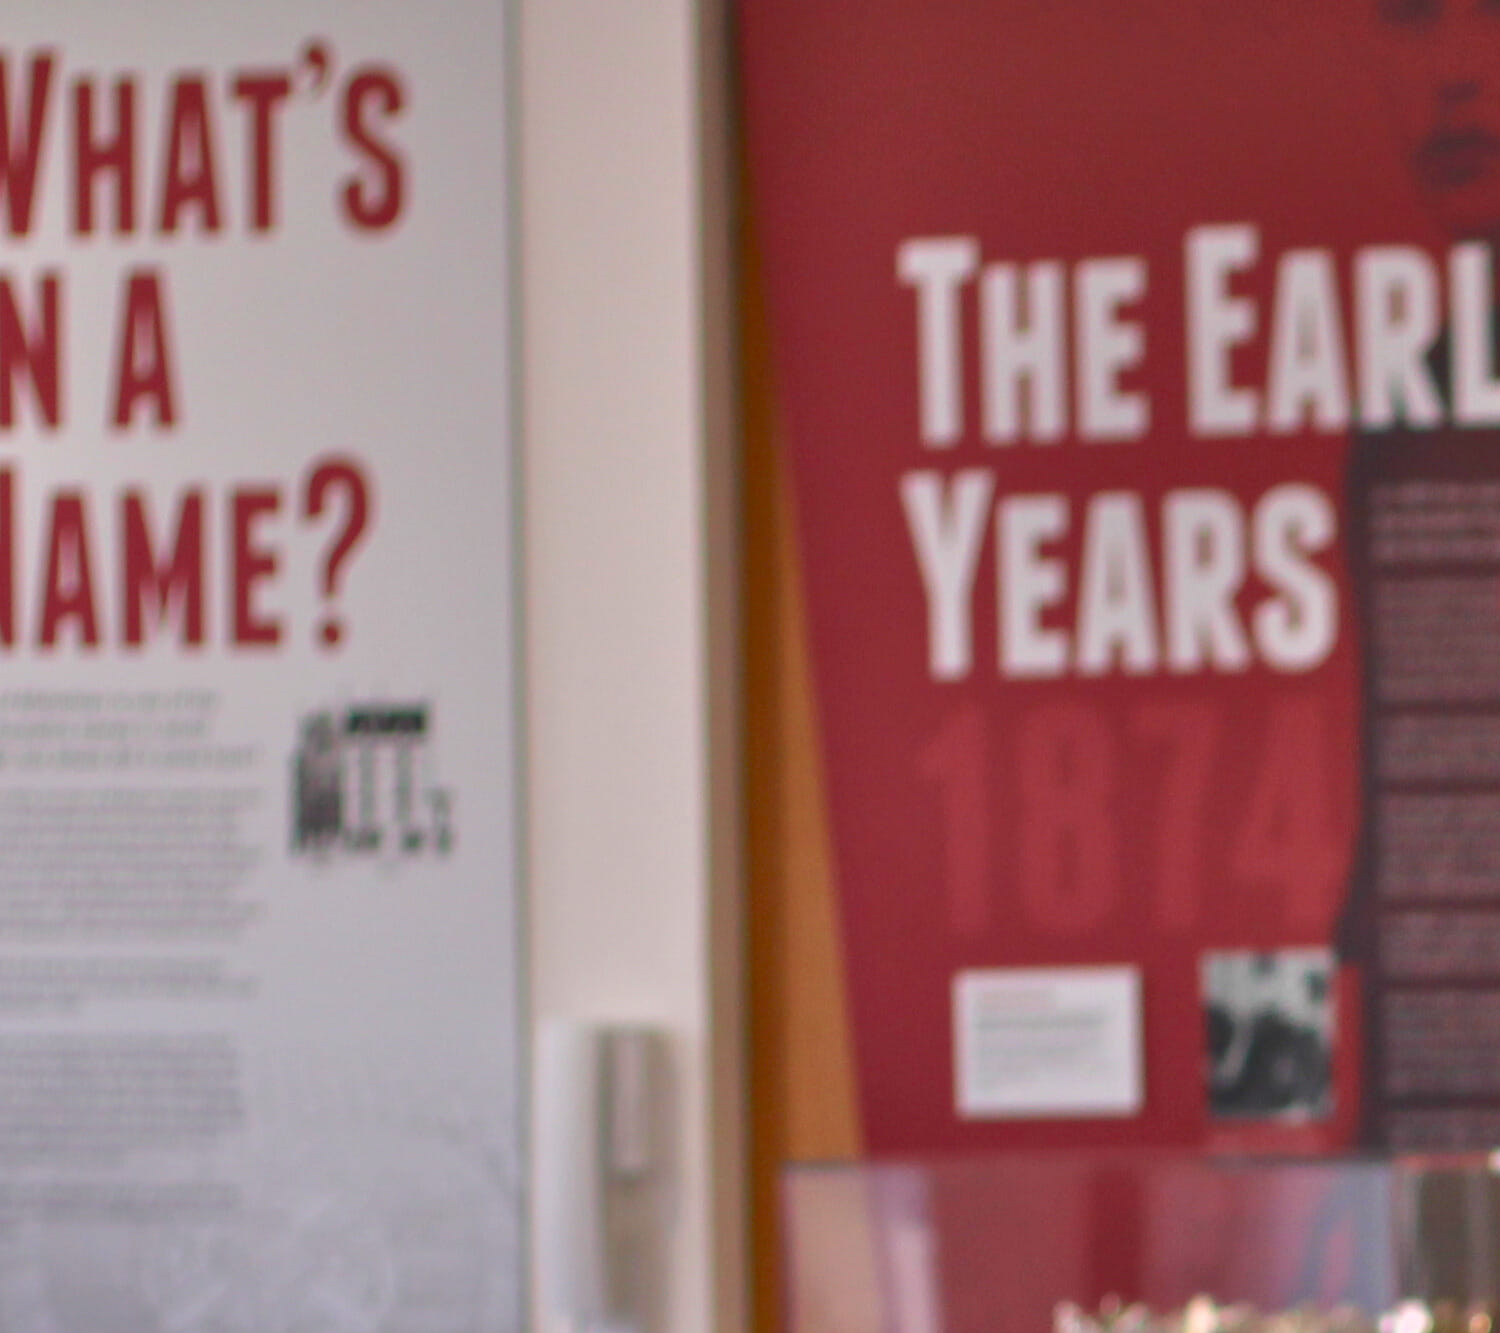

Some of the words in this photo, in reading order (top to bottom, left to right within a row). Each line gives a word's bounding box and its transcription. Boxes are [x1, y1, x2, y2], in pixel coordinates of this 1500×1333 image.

[110, 268, 180, 432] A
[898, 238, 1149, 447] THE
[0, 455, 376, 652] AME?
[901, 469, 1340, 680] YEARS
[914, 695, 1350, 938] 1874
